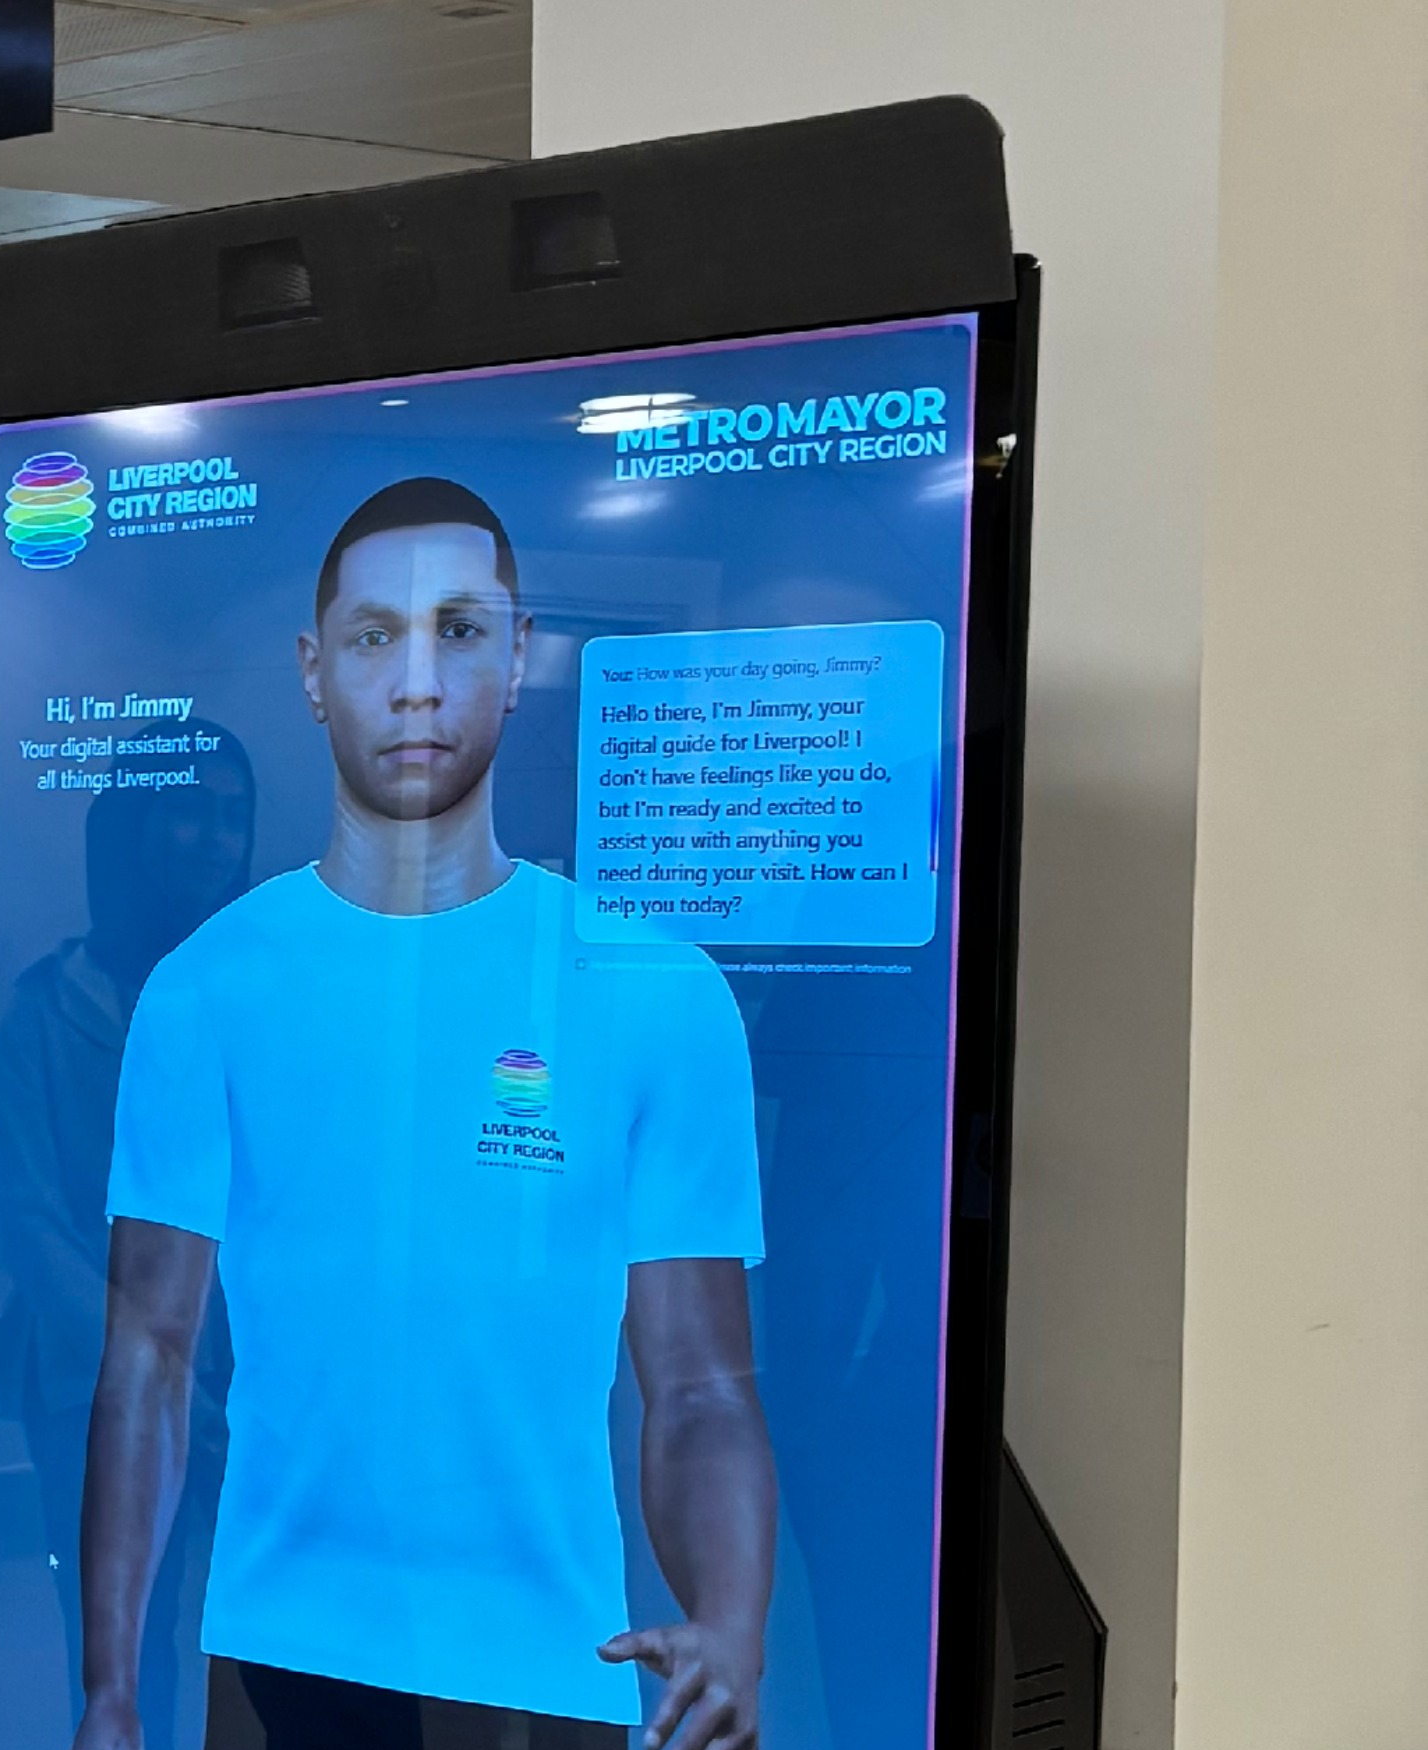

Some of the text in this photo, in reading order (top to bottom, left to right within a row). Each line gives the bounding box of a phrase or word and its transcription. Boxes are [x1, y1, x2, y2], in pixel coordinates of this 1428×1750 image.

[616, 387, 946, 453] METRO MAYOR
[615, 430, 946, 481] LIVERPOOL CITY REGION
[108, 457, 239, 491] LIVERPOOL
[107, 483, 257, 520] CITY REGION
[637, 667, 669, 681] How
[673, 667, 701, 679] was
[704, 665, 738, 682] your
[741, 661, 768, 680] day
[772, 659, 819, 680] going,
[824, 656, 882, 676] Jimmy?
[46, 697, 75, 724] Hi,
[119, 692, 193, 721] Jimmy
[602, 699, 865, 723] Hello there, I'm Jimmy, your
[19, 730, 221, 763] Your digital assistant for
[600, 735, 656, 760] digital
[662, 734, 716, 758] guide
[721, 733, 748, 751] for
[754, 729, 849, 755] Liverpool!
[37, 765, 200, 795] all things Liverpool.
[599, 762, 892, 788] don't have feelings like you do,
[599, 796, 863, 822] but I'm ready and excited to
[597, 830, 863, 855] assist you with anything you
[597, 864, 642, 882] need
[647, 864, 708, 887] during
[712, 868, 756, 887] your
[761, 863, 805, 881] visit.
[811, 863, 856, 881] How
[861, 868, 896, 881] can
[597, 895, 742, 919] help you today?
[482, 1123, 560, 1142] LIVERPOOL
[477, 1141, 564, 1162] CITY REGION
